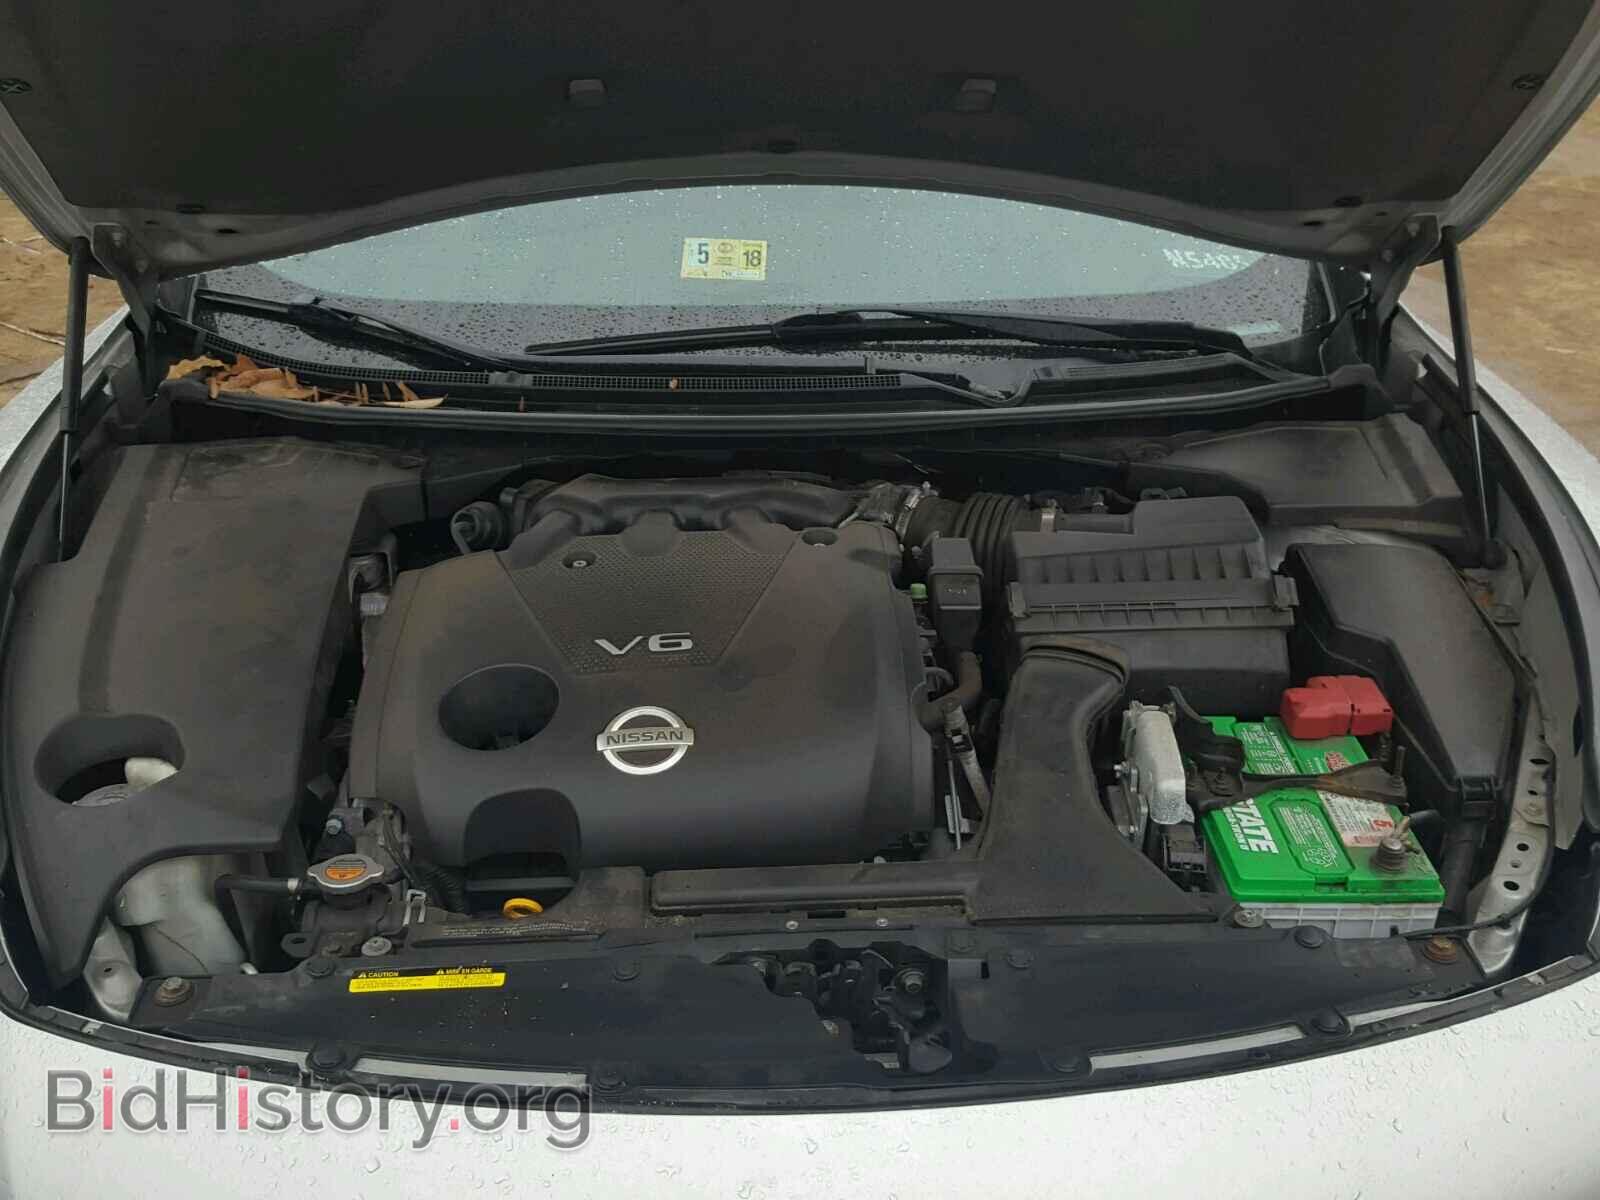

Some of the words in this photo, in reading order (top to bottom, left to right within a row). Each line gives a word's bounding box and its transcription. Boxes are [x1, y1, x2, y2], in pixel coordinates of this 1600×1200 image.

[697, 243, 709, 265] 5
[742, 250, 762, 267] 18
[594, 632, 693, 655] V6
[606, 730, 684, 746] NISSAN
